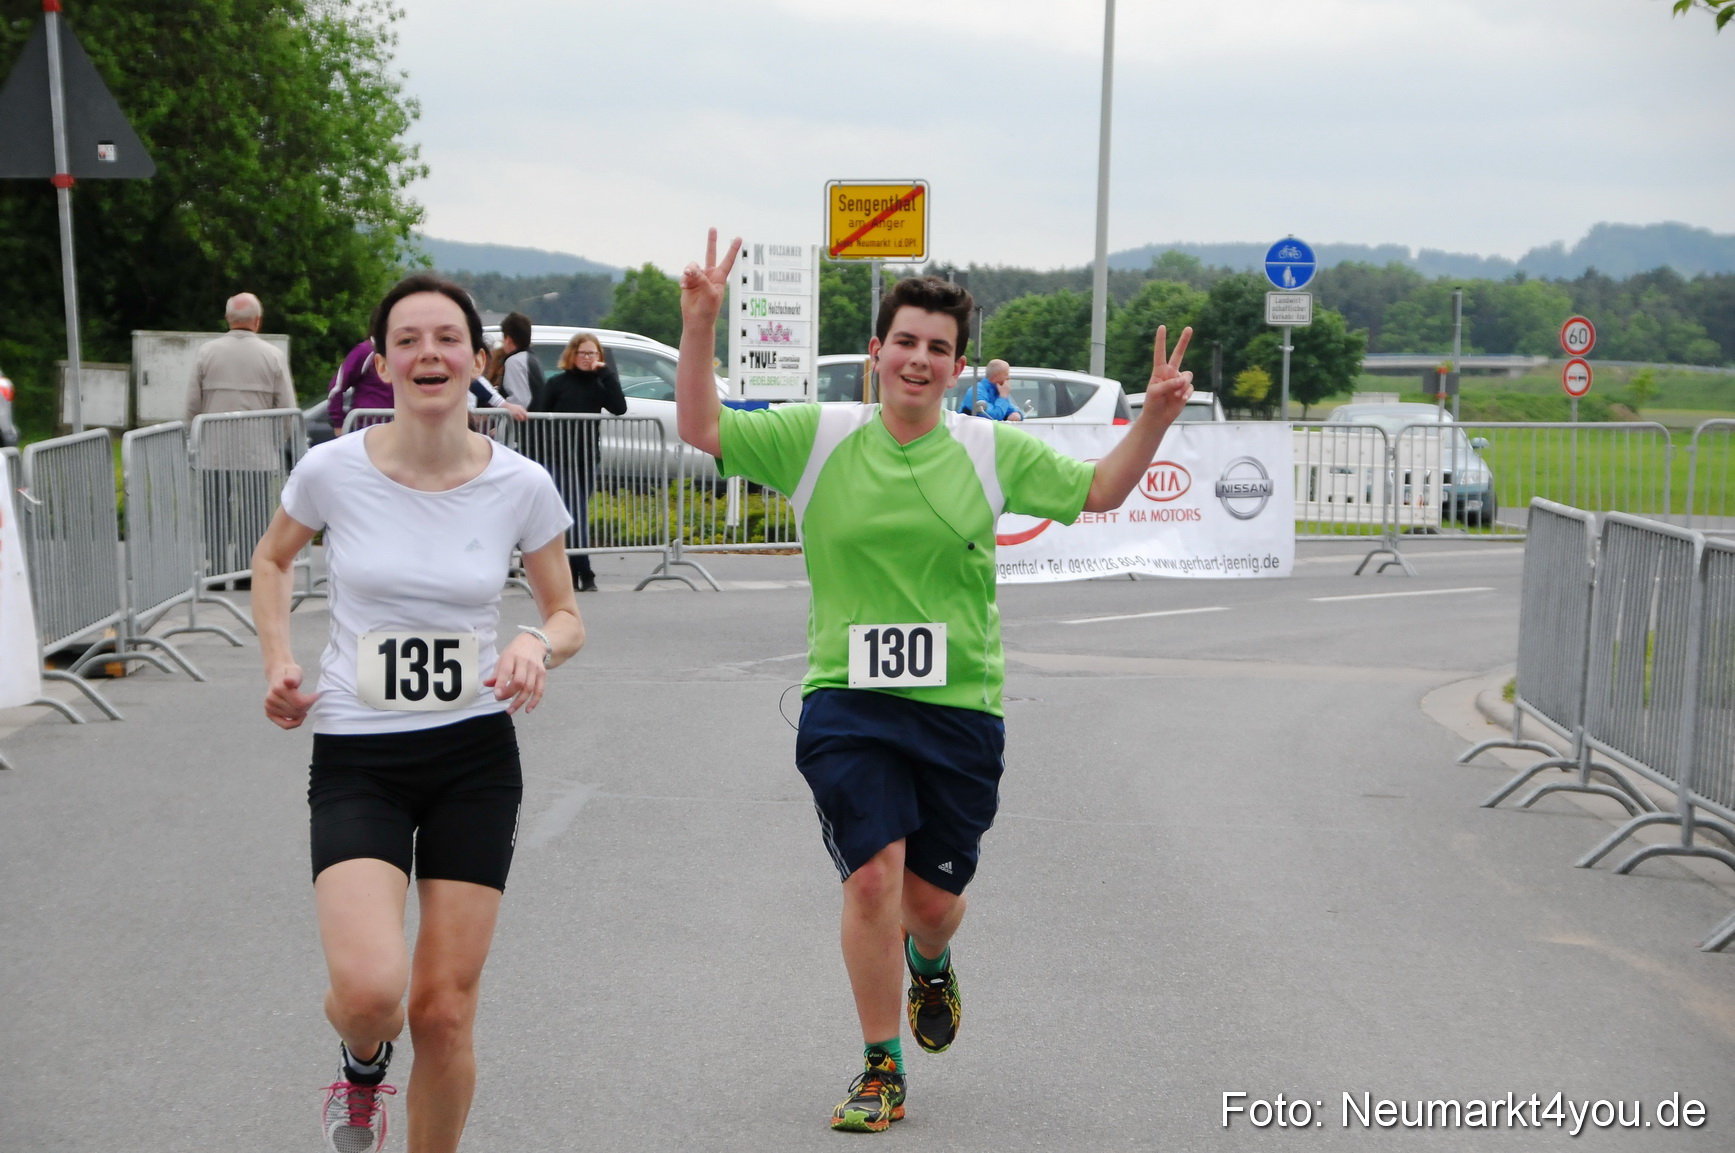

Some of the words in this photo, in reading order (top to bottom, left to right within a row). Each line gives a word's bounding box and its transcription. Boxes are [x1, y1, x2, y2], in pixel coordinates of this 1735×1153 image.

[838, 193, 916, 217] Sengenthal
[848, 219, 866, 228] am
[871, 217, 905, 231] Anger
[856, 238, 891, 247] Neumarkt
[768, 301, 801, 316] Holzfachmarkt
[1569, 327, 1588, 345] 60
[749, 350, 777, 369] THULE
[1146, 471, 1181, 492] KIA
[1221, 483, 1268, 494] NISSAN
[1129, 509, 1147, 523] KIA
[1151, 508, 1202, 522] MOTORS
[995, 559, 1039, 579] ngenthal
[1047, 559, 1067, 574] Tel.
[1068, 558, 1118, 574] 09181/26
[1117, 555, 1146, 567] 80-0
[1152, 553, 1280, 574] www.gerhart-jaenig.de
[864, 627, 933, 678] 130
[378, 637, 462, 702] 135
